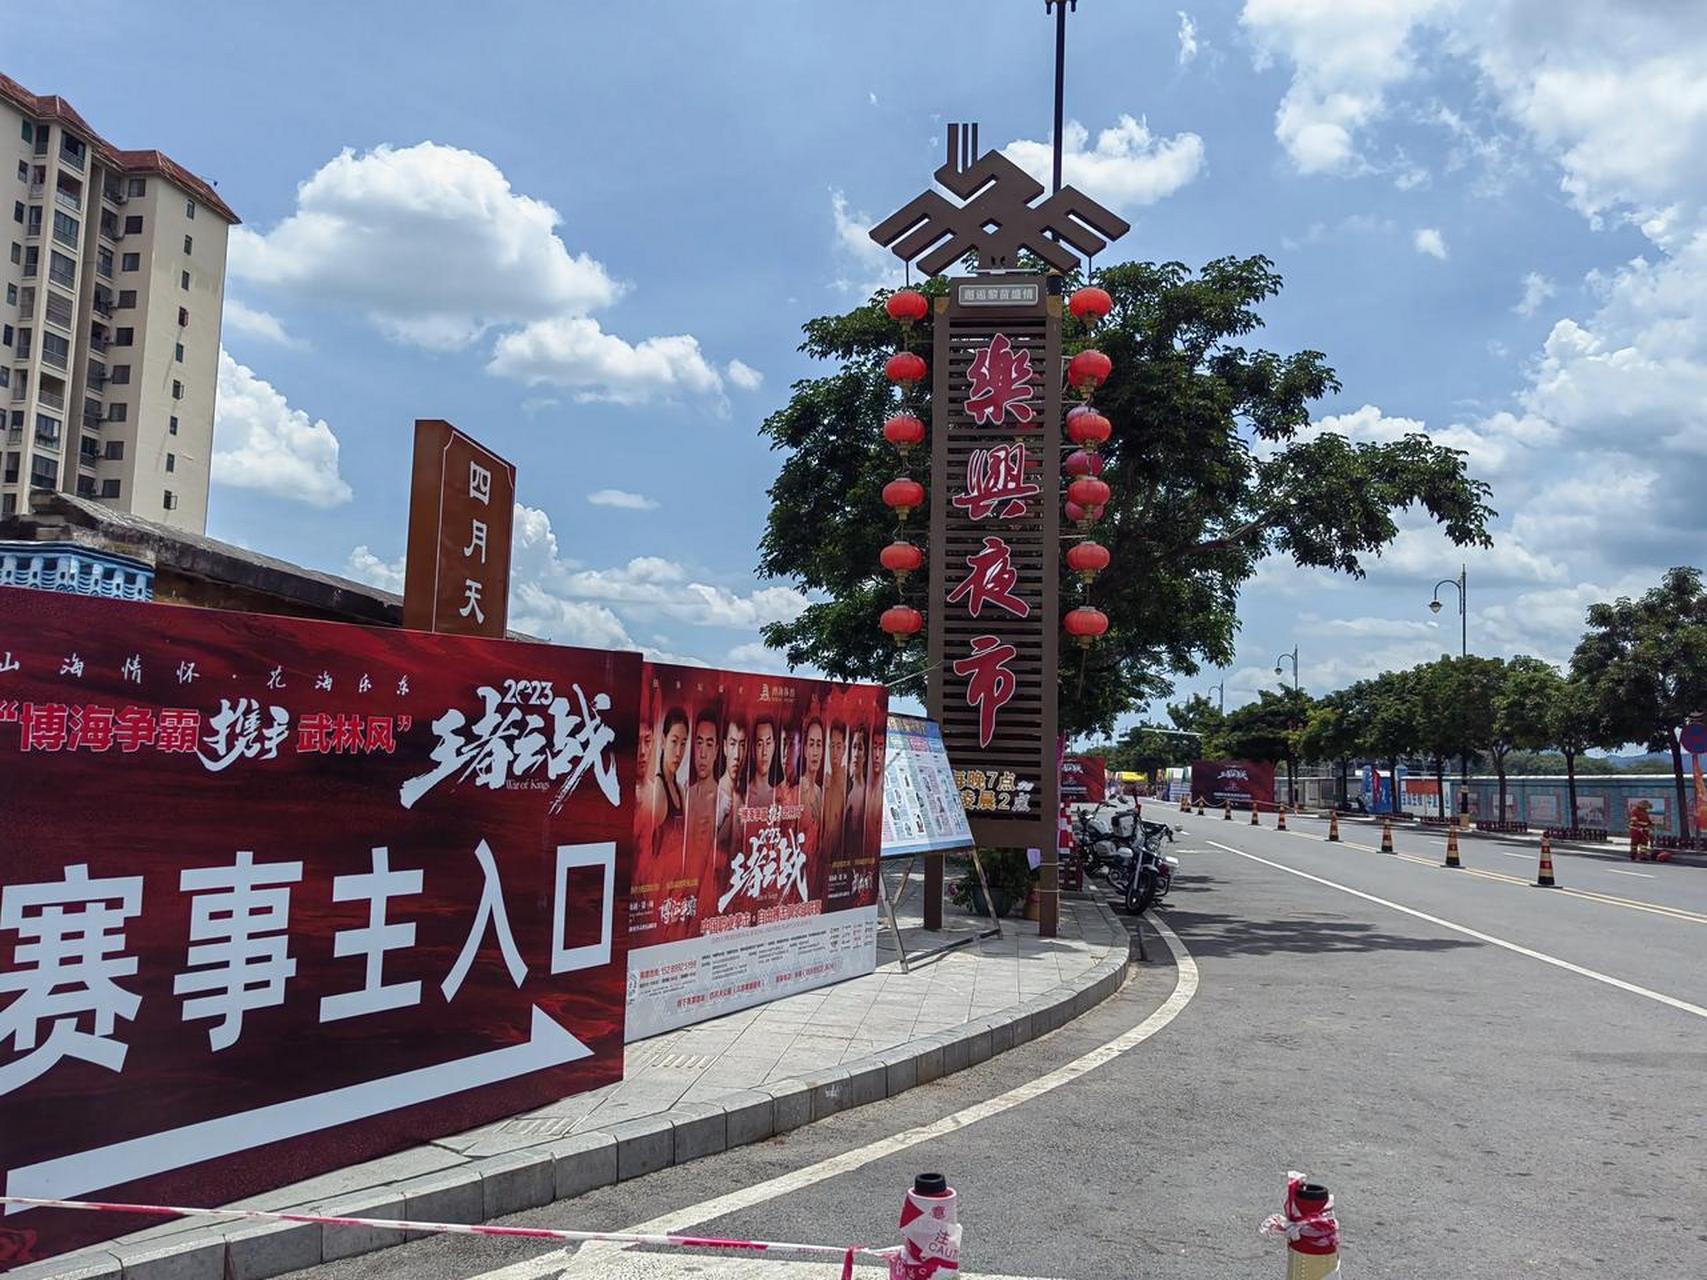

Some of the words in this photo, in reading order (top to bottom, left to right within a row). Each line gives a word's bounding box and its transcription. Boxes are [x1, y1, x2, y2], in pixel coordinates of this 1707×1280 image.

[459, 460, 491, 625] 四月天
[947, 332, 1040, 749] 樂興夜市
[503, 679, 554, 705] 2023
[0, 838, 617, 1094] 赛事主入口
